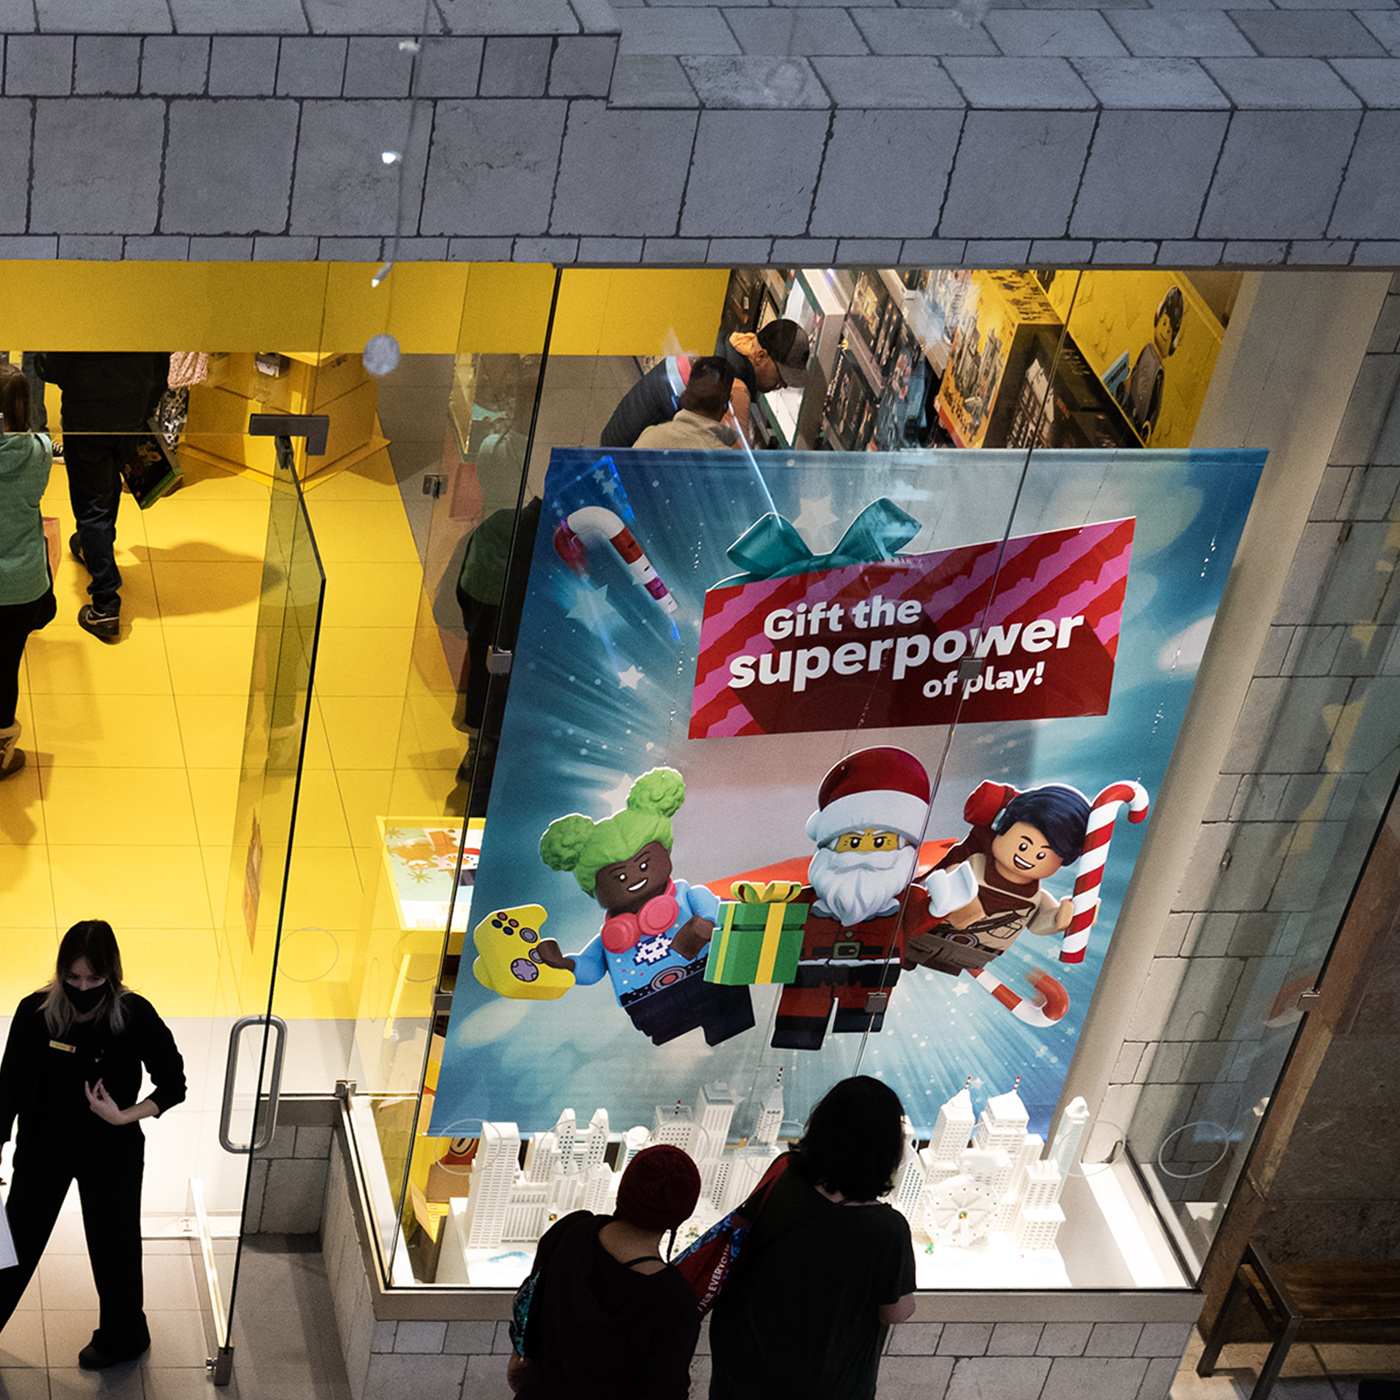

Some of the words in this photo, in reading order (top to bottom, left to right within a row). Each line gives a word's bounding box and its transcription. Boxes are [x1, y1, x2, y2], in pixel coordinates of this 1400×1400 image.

[763, 600, 844, 640] Gift
[852, 595, 922, 632] the
[727, 615, 1084, 692] superpower
[922, 671, 959, 698] of
[962, 661, 1045, 700] play!
